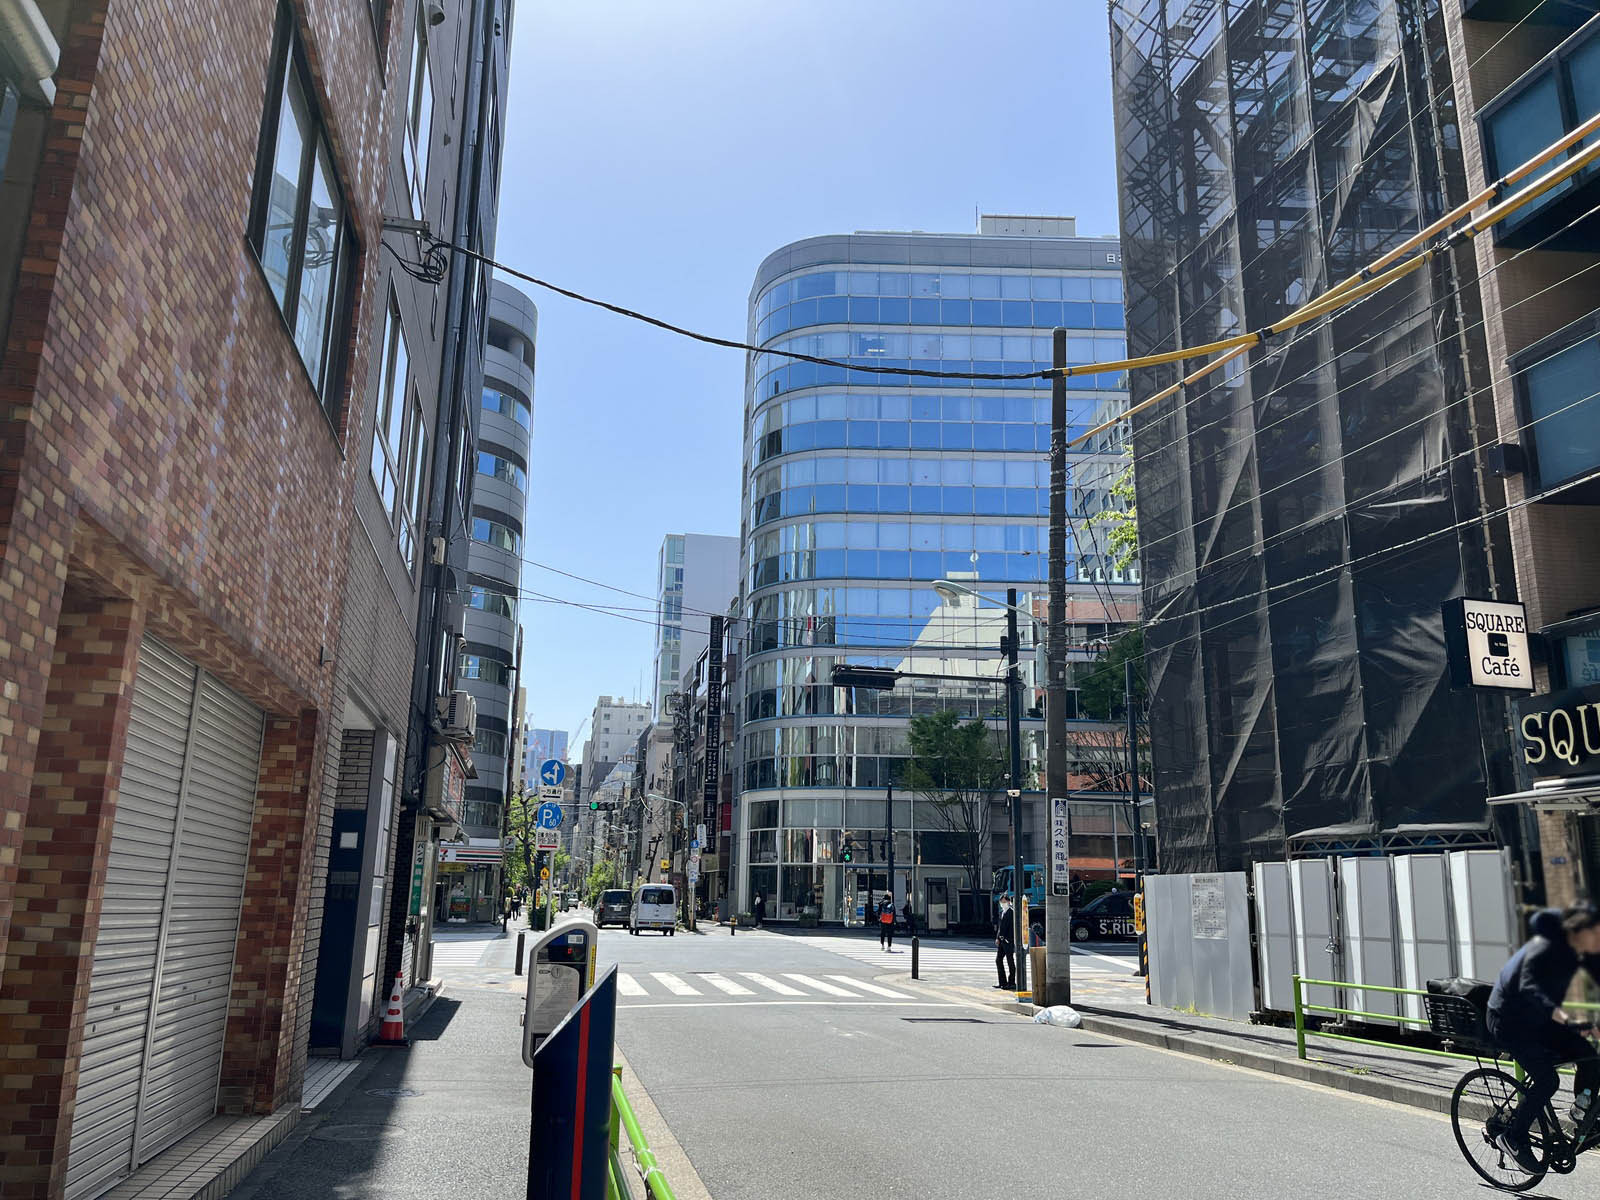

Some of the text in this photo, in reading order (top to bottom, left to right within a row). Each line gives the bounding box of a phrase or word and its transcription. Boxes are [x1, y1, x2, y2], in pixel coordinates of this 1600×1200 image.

[1466, 612, 1525, 634] SQUARE
[1482, 656, 1520, 677] Café
[1521, 703, 1600, 766] SQU
[543, 809, 552, 825] P
[548, 819, 557, 827] 60
